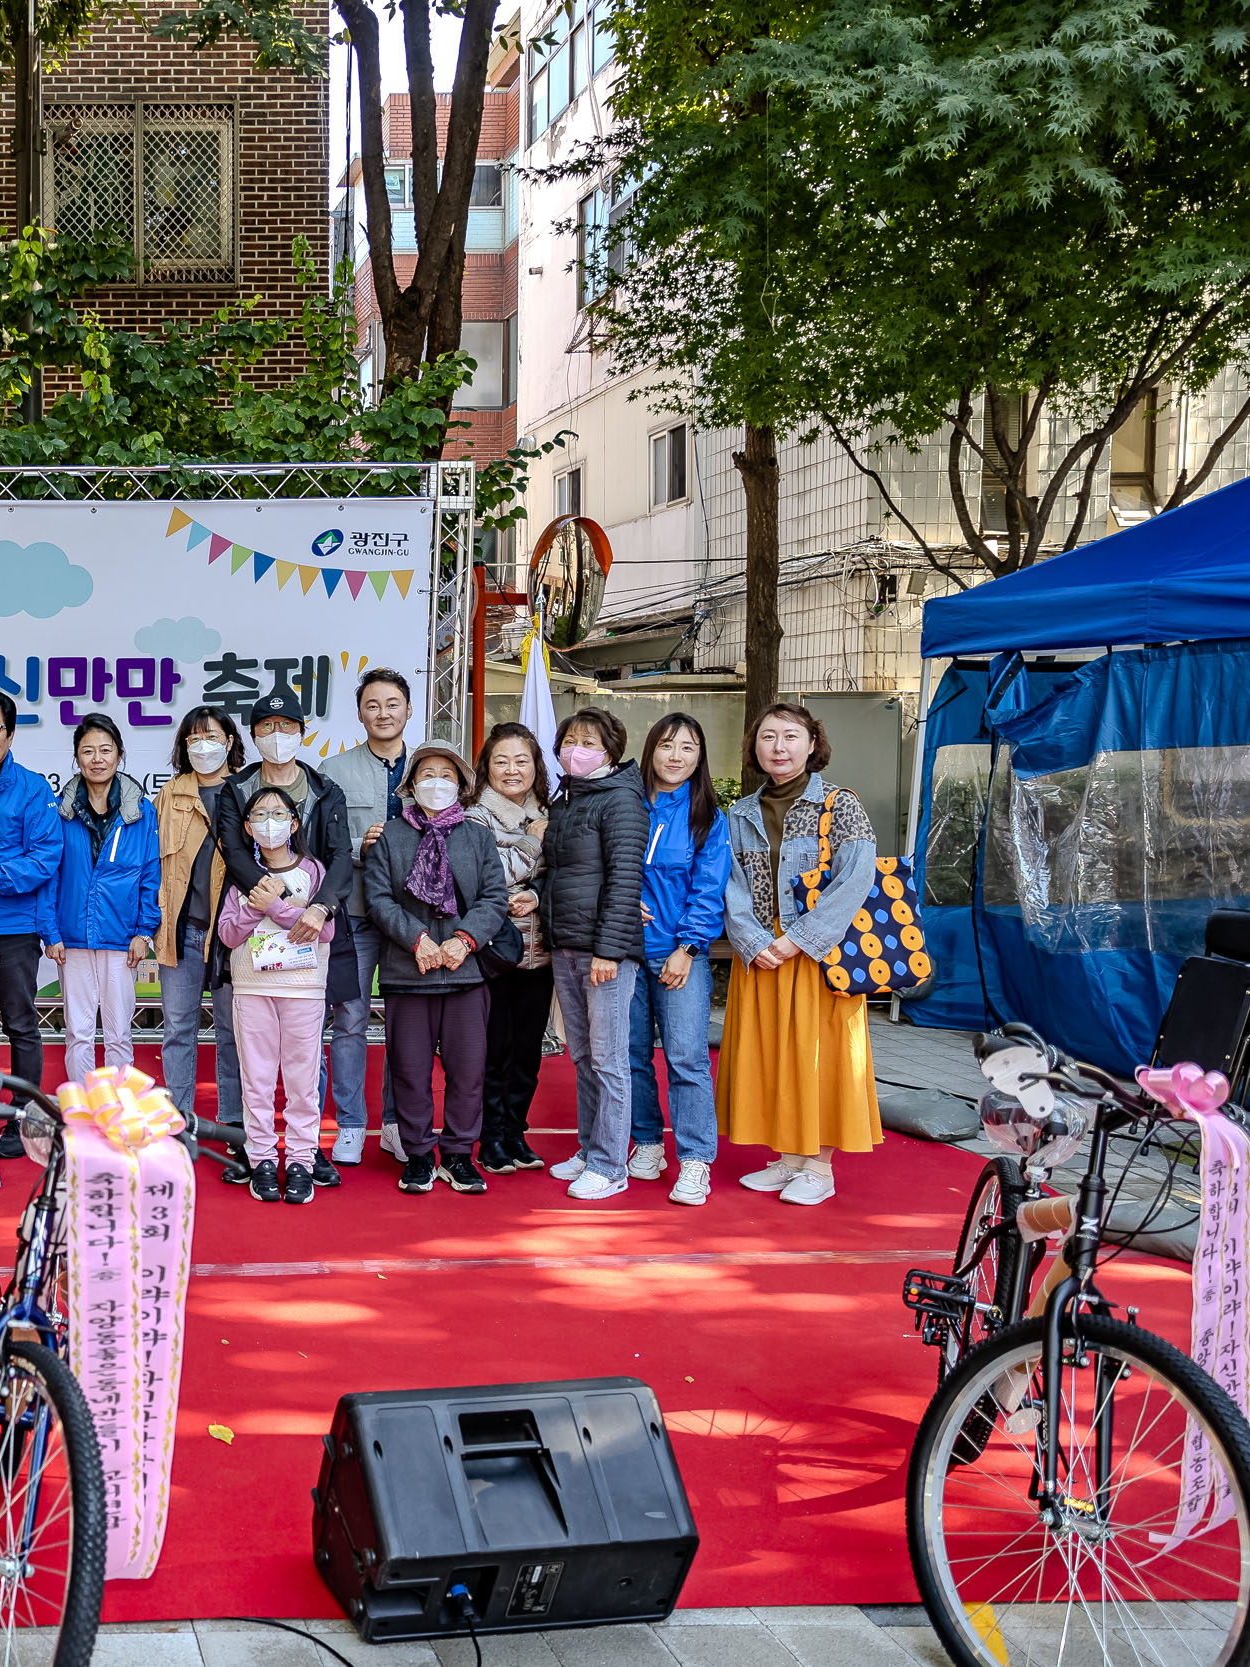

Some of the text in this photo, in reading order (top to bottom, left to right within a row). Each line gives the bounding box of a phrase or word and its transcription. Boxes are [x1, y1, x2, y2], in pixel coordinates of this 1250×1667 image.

[351, 530, 410, 548] 광진구
[348, 548, 410, 557] GWANGJIN-GU
[202, 652, 331, 726] 축제
